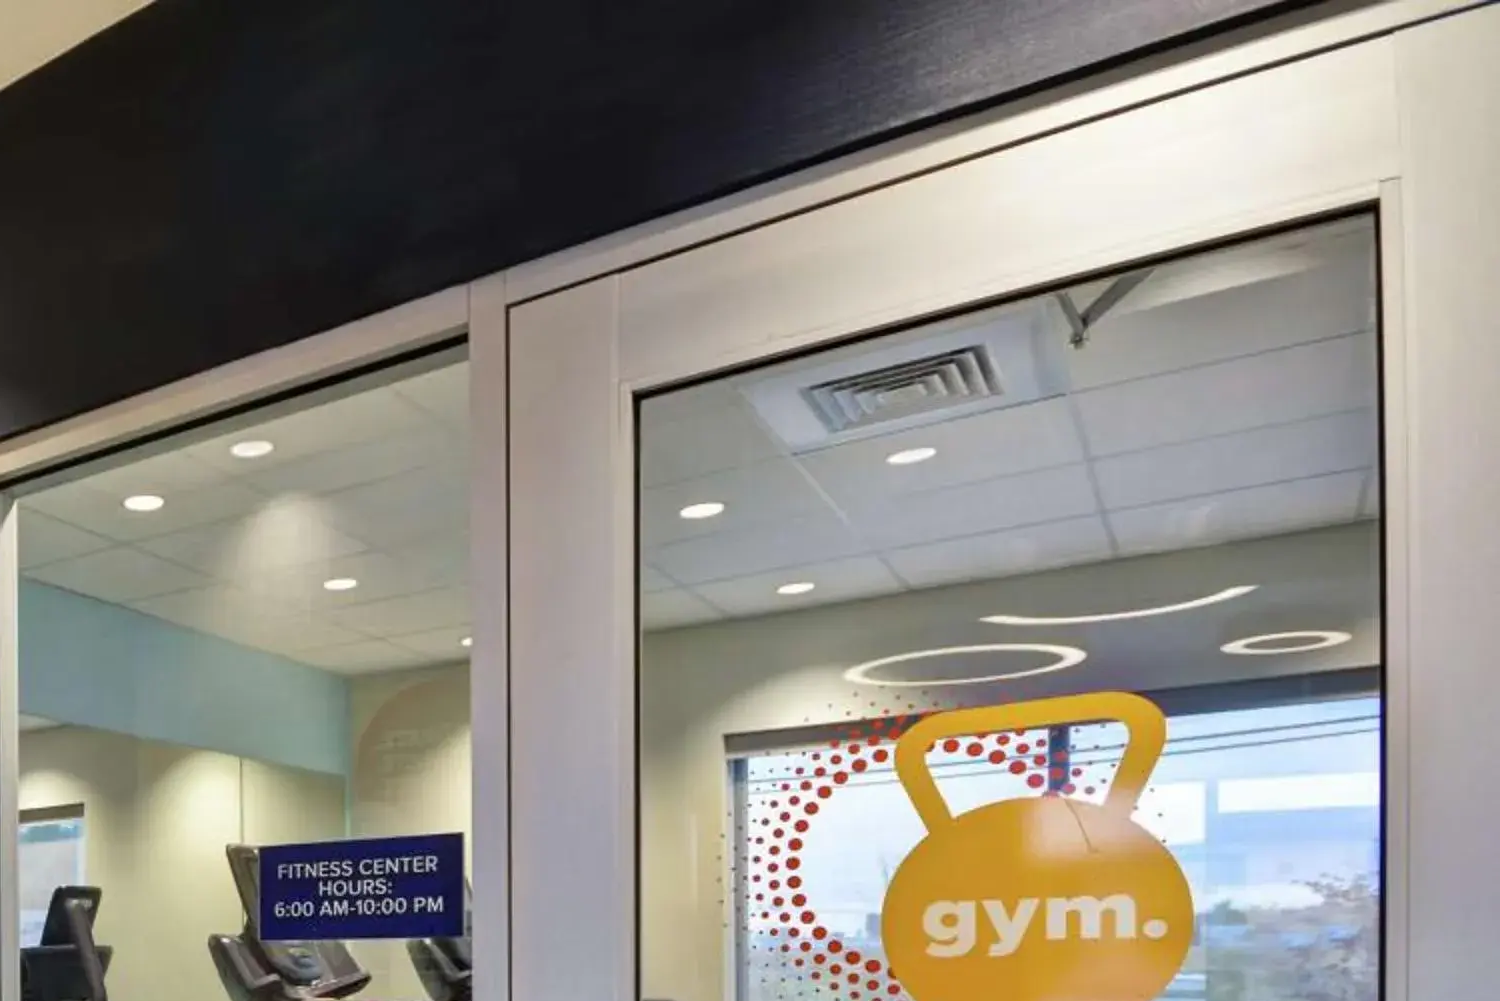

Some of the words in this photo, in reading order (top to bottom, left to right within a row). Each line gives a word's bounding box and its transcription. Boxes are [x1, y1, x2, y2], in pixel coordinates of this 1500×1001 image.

[277, 860, 353, 879] FITNESS
[359, 855, 438, 875] CENTER
[318, 878, 393, 897] HOURS:
[274, 901, 314, 917] 6:00
[319, 897, 407, 917] AM-10:00
[413, 895, 444, 914] PM
[922, 893, 1169, 958] gym.
